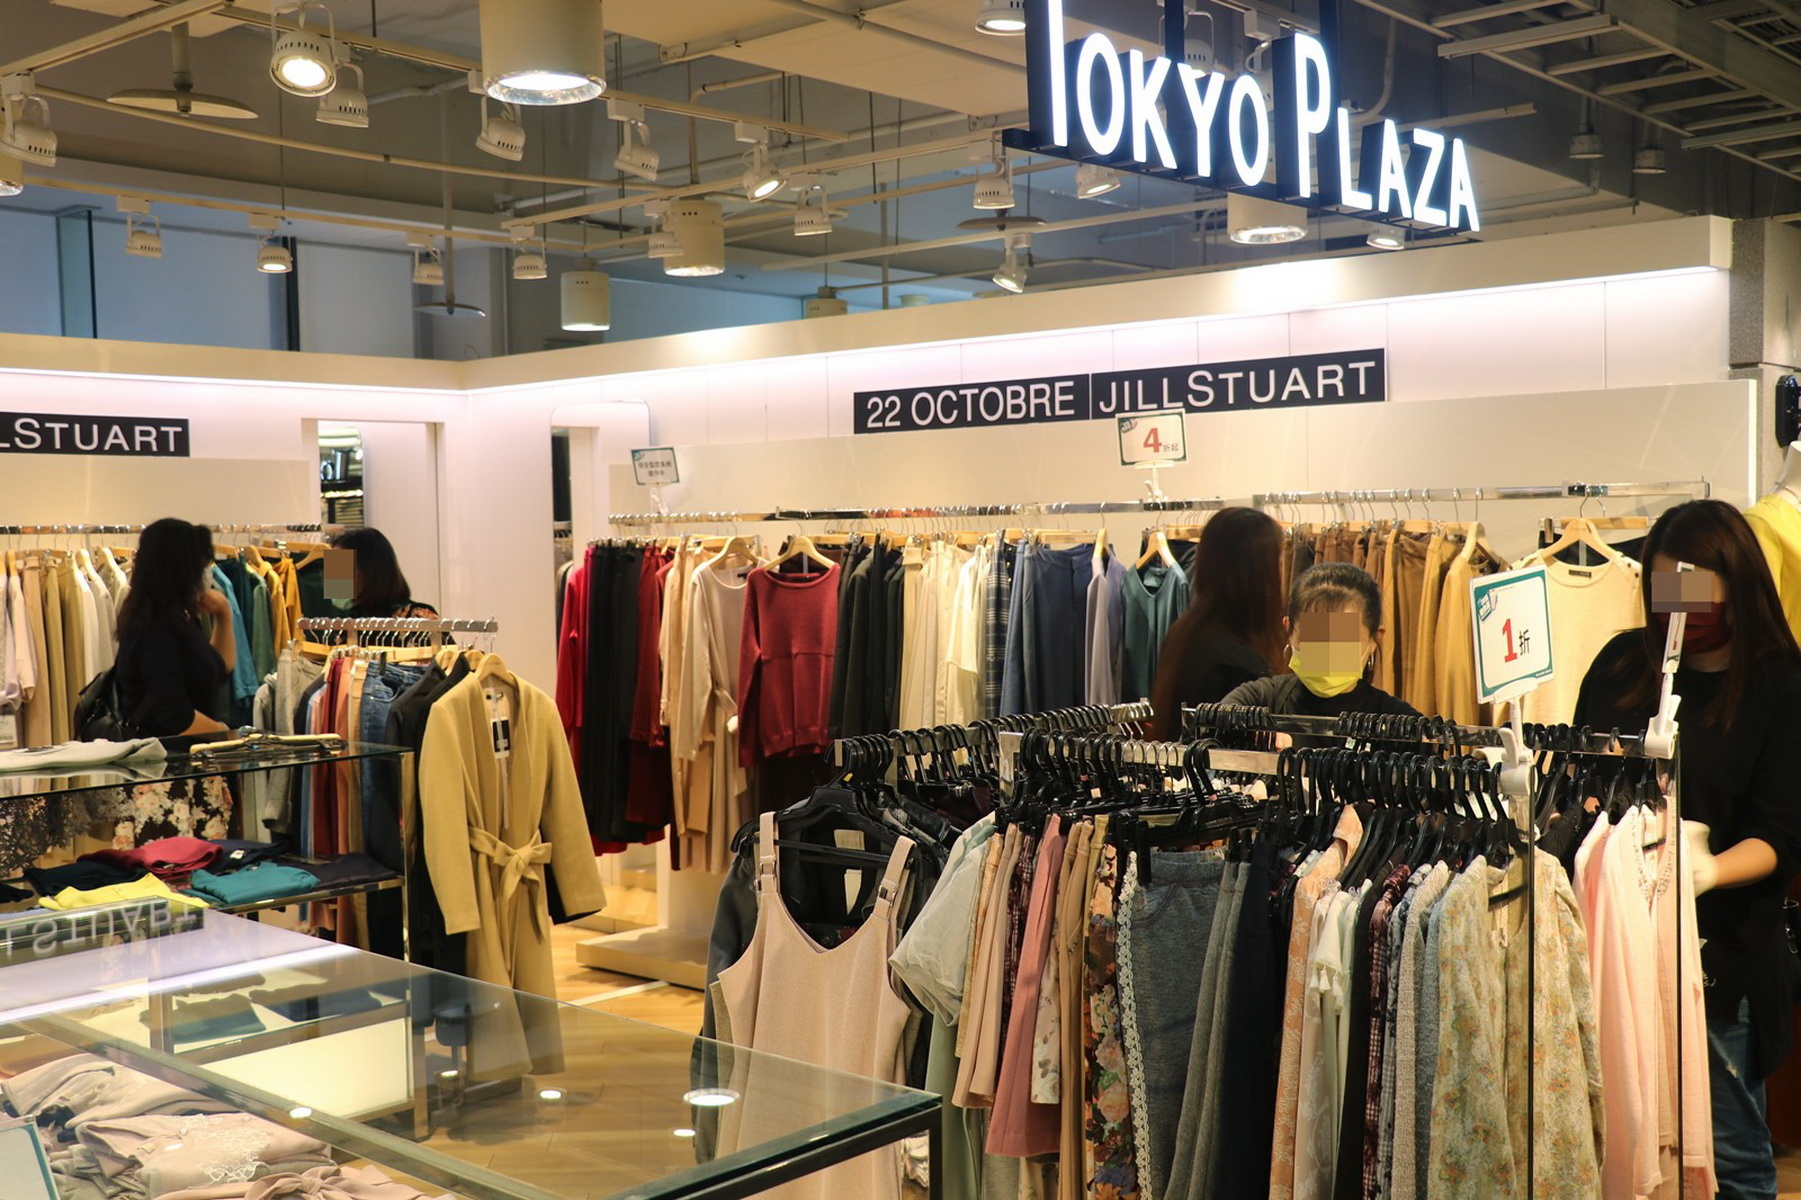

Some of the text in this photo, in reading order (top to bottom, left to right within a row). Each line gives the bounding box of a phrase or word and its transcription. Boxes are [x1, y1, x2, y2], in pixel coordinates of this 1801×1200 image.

[1294, 32, 1480, 232] PLAZA
[867, 381, 1075, 428] 22 OCTOBRE
[1099, 361, 1376, 413] JILLSTUART
[0, 417, 183, 452] STUART
